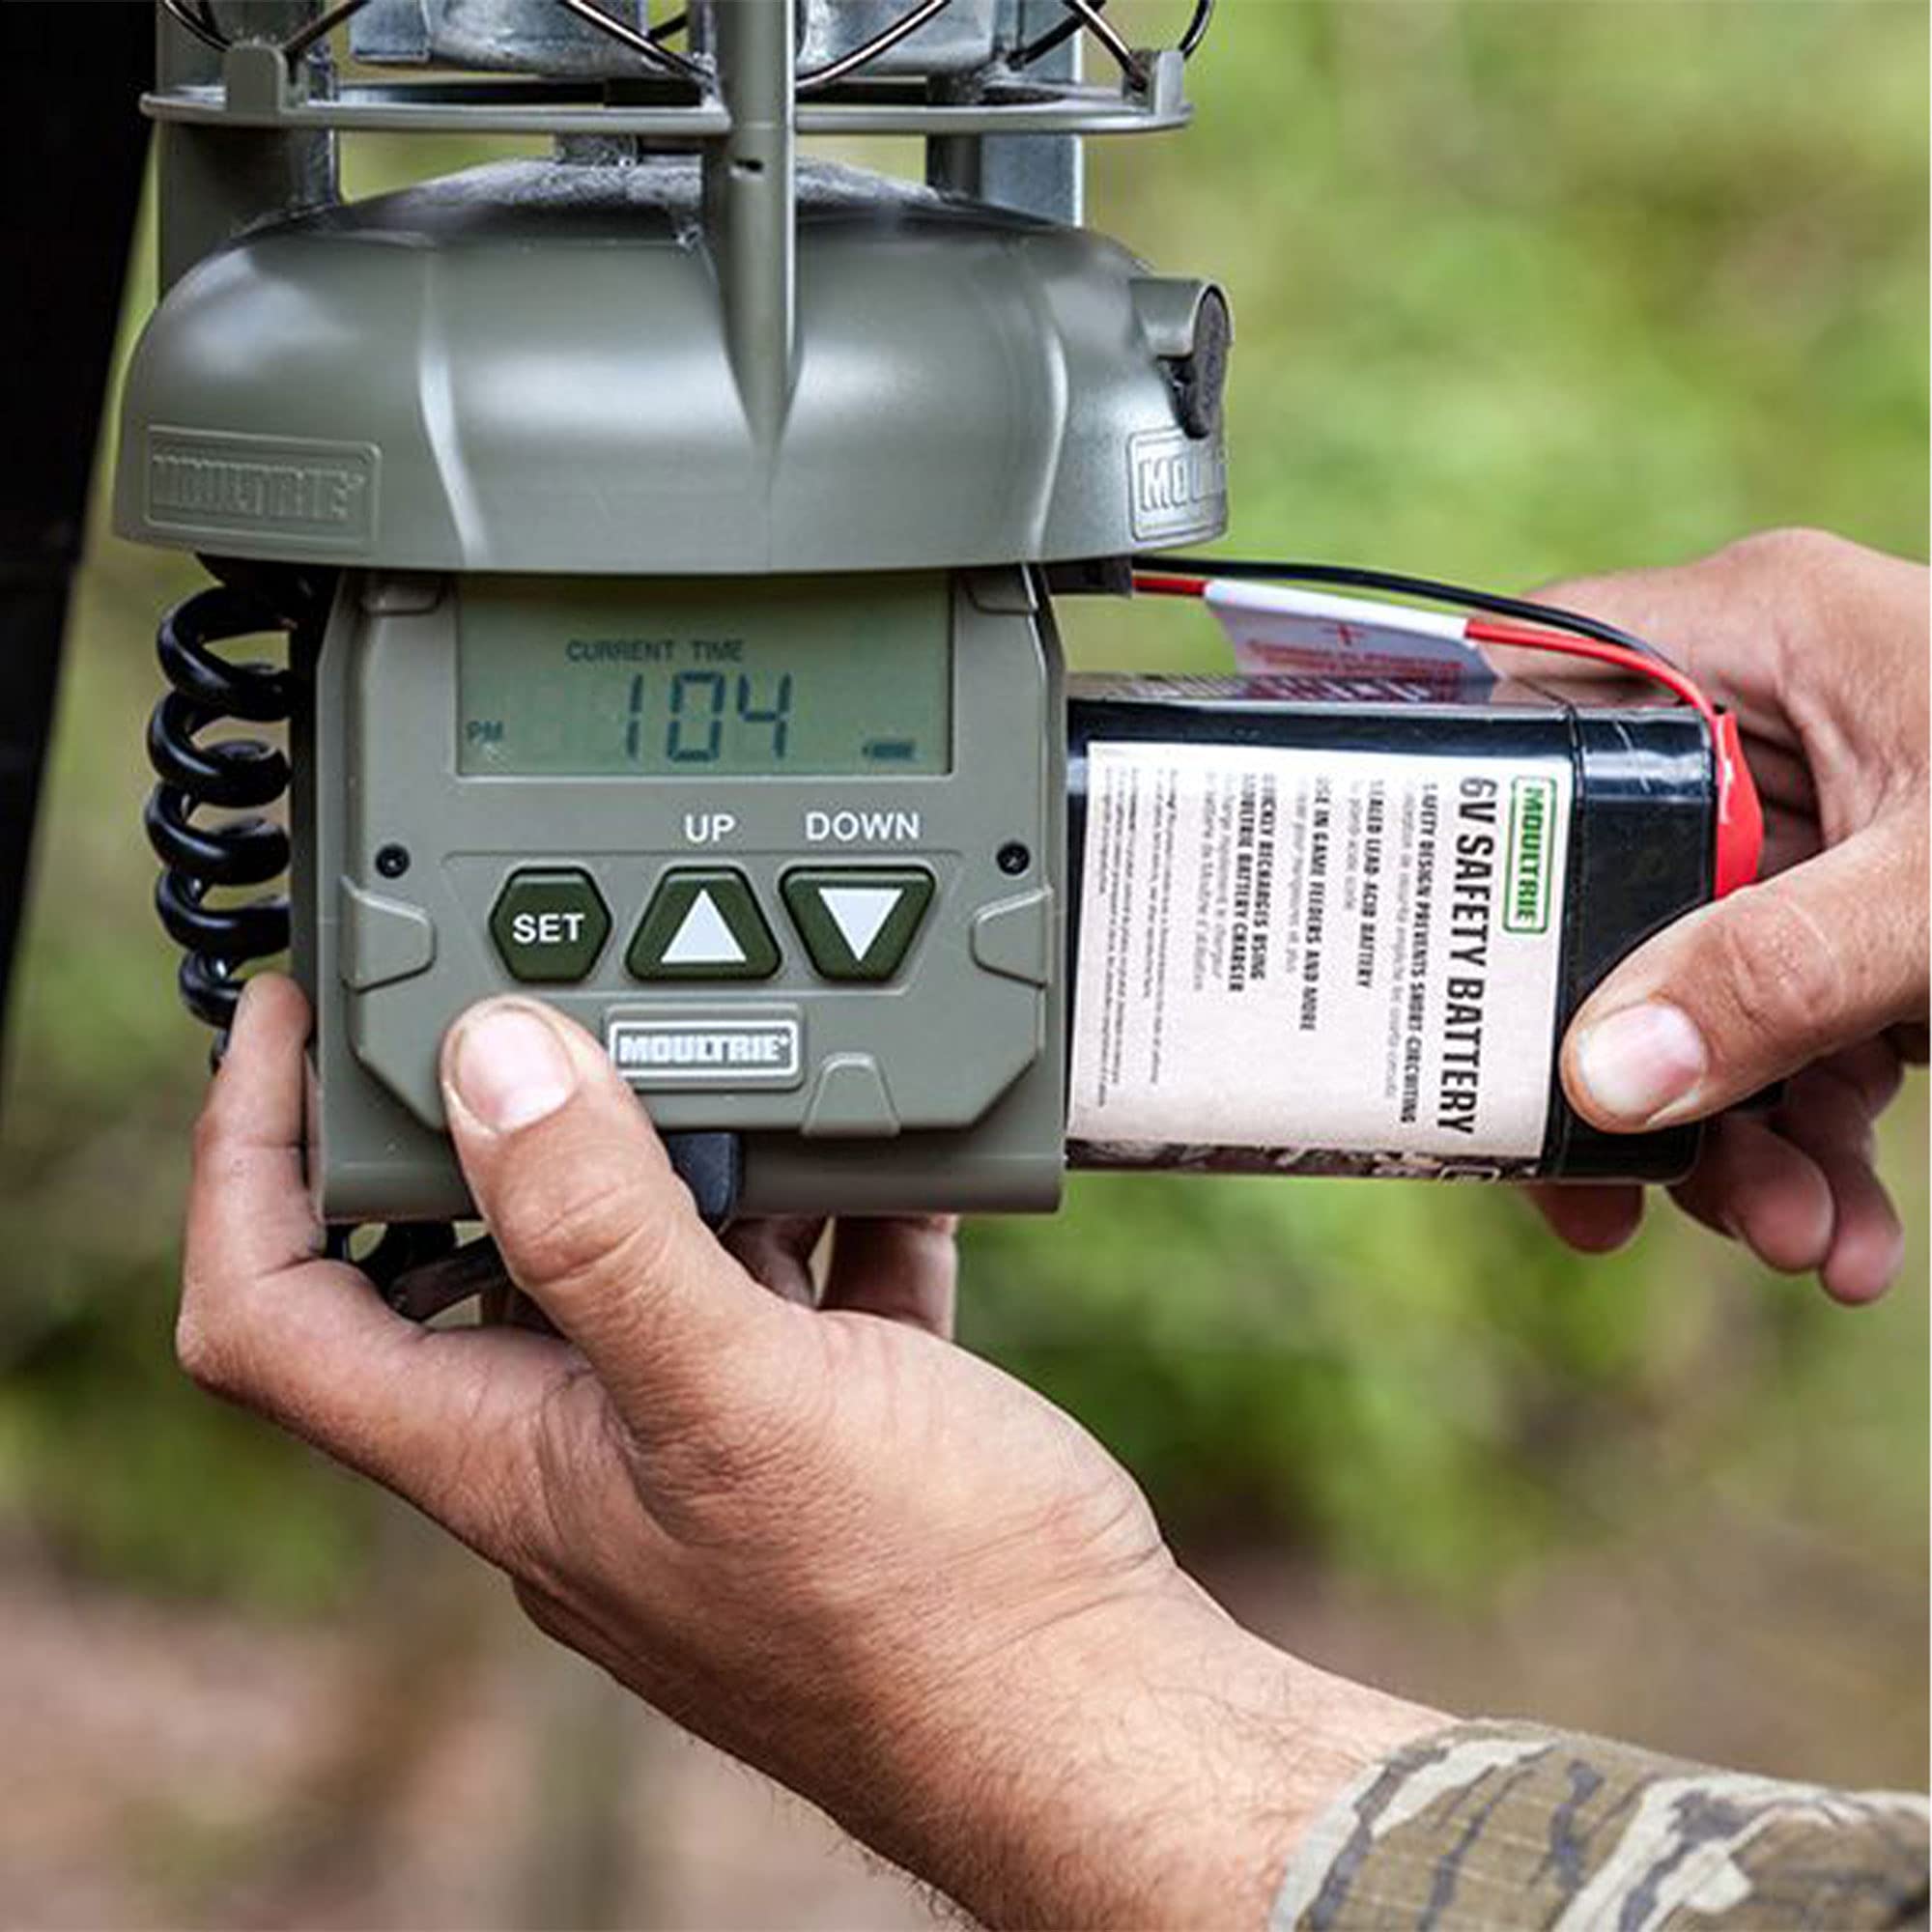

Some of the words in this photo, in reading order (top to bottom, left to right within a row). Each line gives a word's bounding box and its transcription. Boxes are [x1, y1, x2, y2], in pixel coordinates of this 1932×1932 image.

[566, 639, 675, 663] CURRENT
[692, 639, 747, 663] TIME
[625, 670, 792, 762] 104
[684, 813, 736, 842] UP
[805, 811, 920, 841] DOWN
[1314, 810, 1329, 827] IN
[1459, 778, 1497, 824] 6V
[1311, 833, 1329, 875] GAME
[1417, 840, 1435, 896] DESIGN
[1516, 787, 1545, 922] MOULTRIE
[1234, 853, 1253, 919] BATTERY
[1254, 840, 1274, 927] RECHARGES
[1449, 834, 1495, 967] SAFETY
[512, 913, 584, 944] SET
[1306, 881, 1326, 944] FEEDERS
[1410, 898, 1432, 978] PREVENTS
[1229, 923, 1249, 992] CHARGER
[1250, 933, 1268, 980] USING
[1303, 950, 1321, 982] AND
[1356, 923, 1377, 988] BATTERY
[1299, 987, 1319, 1031] MORE
[1436, 977, 1486, 1134] BATTERY
